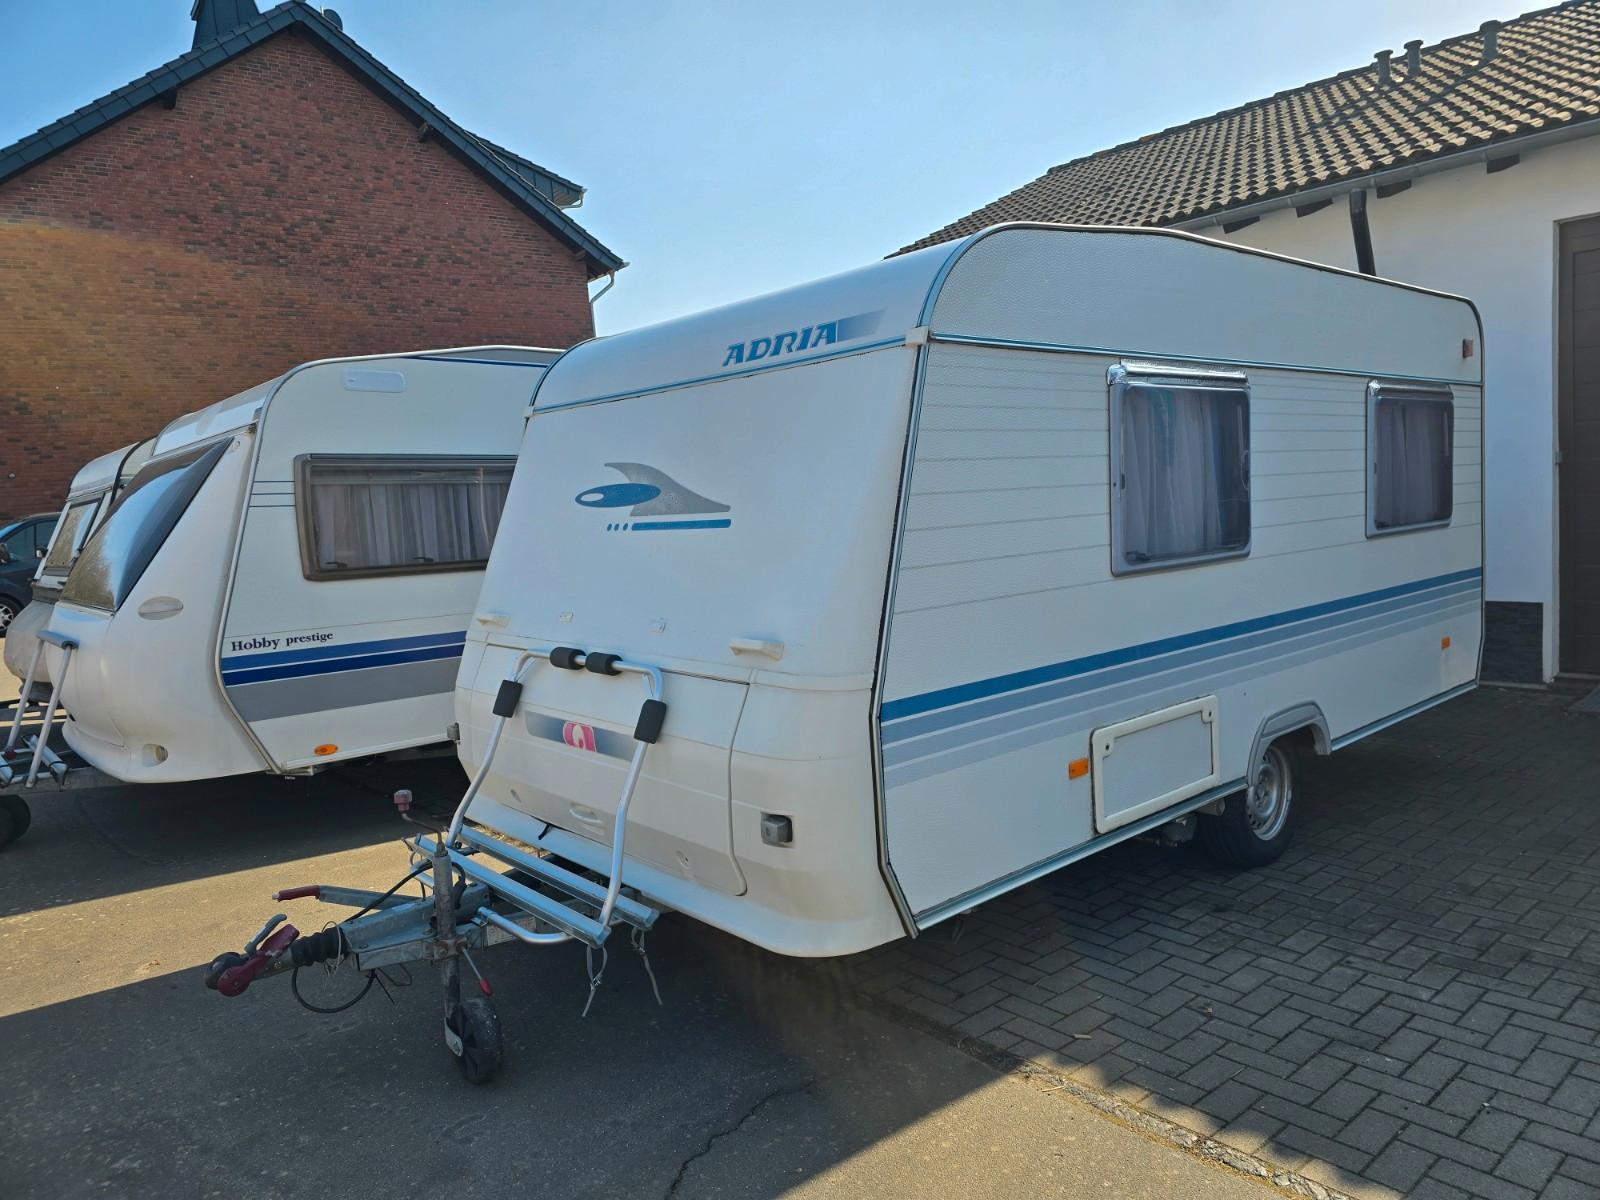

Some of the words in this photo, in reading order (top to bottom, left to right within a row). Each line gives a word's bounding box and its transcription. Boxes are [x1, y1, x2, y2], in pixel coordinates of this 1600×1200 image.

[722, 321, 838, 367] ADRIA
[231, 636, 280, 652] Hobby
[285, 632, 333, 647] prestige
